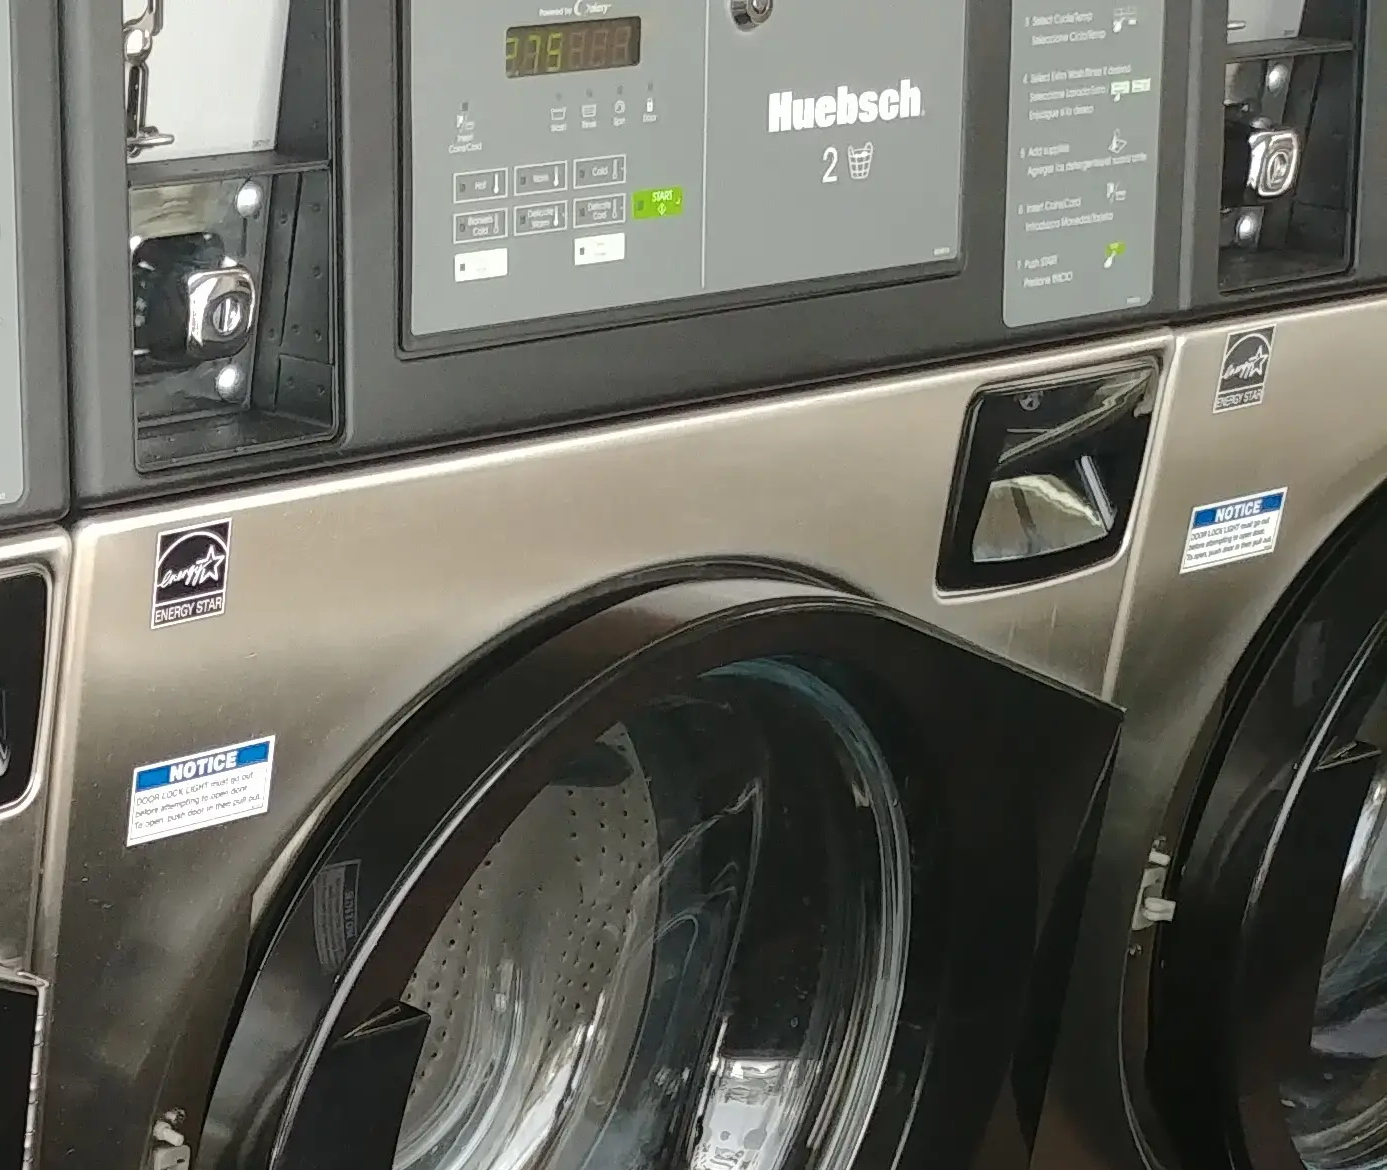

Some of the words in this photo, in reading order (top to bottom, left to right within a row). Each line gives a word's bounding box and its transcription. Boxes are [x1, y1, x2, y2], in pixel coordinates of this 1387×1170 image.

[768, 78, 921, 133] Huebsch
[822, 146, 838, 183] 2
[650, 189, 674, 203] START
[1215, 500, 1263, 522] NOTICE
[154, 601, 195, 624] ENERGY
[195, 596, 223, 614] STAR
[169, 751, 238, 782] NOTICE
